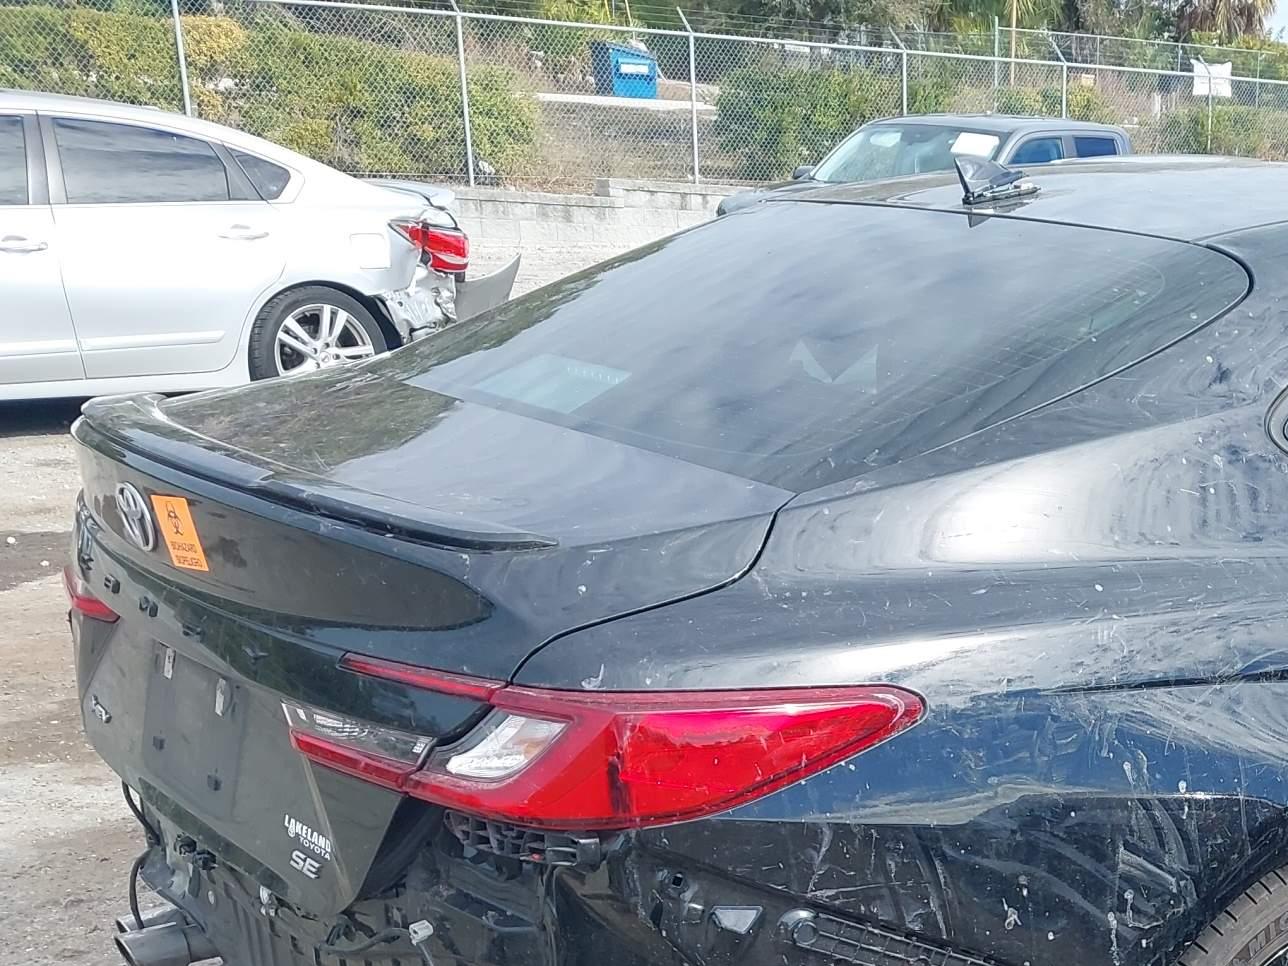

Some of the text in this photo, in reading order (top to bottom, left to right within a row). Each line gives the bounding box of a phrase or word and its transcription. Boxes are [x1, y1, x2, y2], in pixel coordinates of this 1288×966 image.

[284, 814, 332, 853] LAKELAND
[299, 836, 331, 861] TOYOTA
[289, 849, 323, 879] SE
